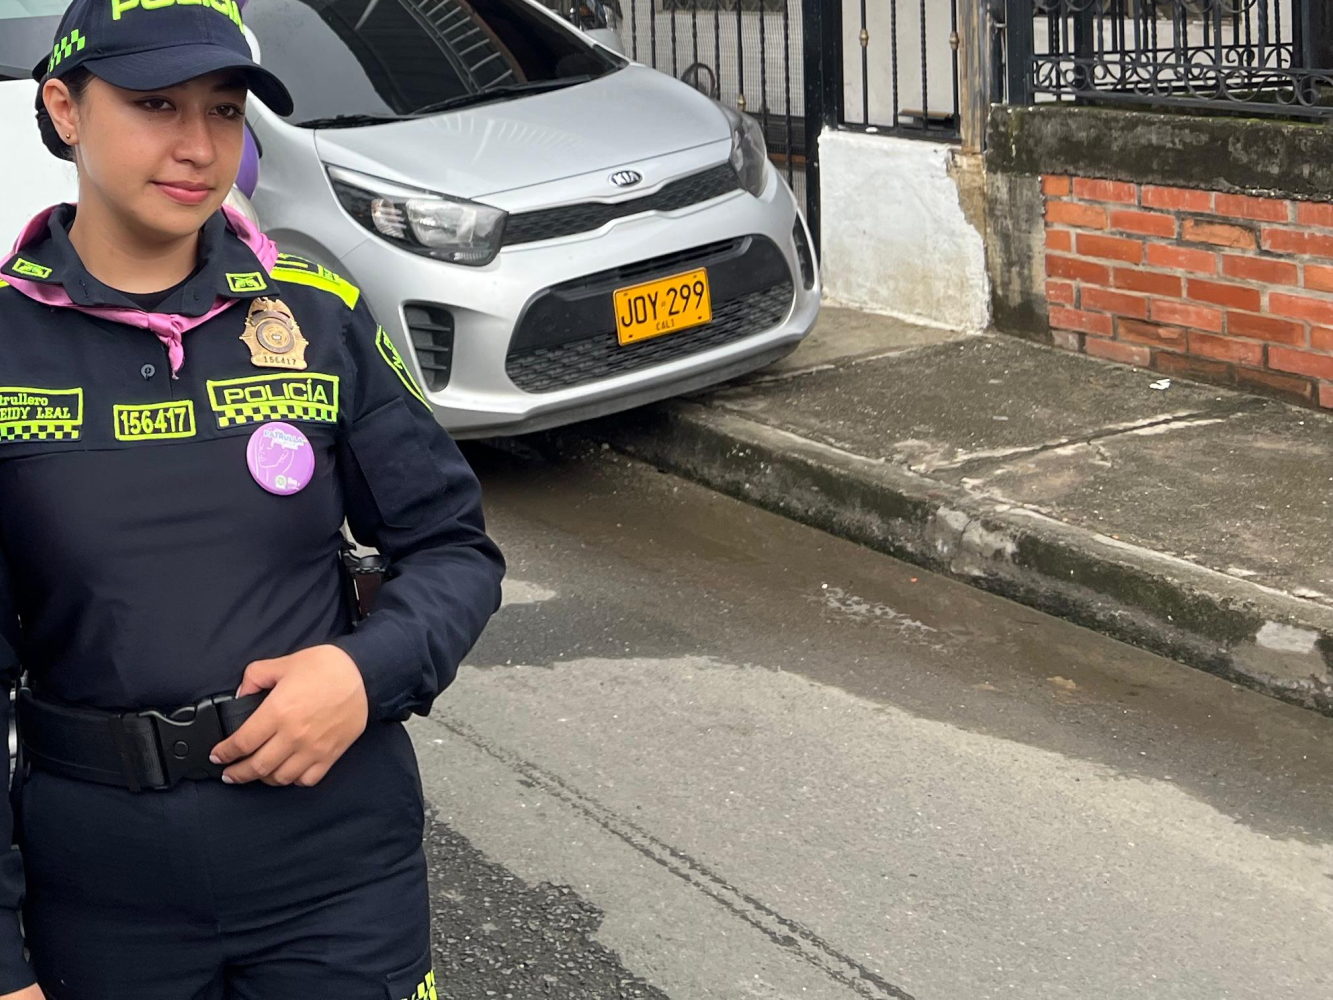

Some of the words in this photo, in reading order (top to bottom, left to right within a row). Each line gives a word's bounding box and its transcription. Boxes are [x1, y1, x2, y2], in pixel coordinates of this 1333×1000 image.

[611, 171, 642, 187] KIA
[666, 280, 705, 316] 299
[655, 320, 675, 331] CALI
[222, 378, 329, 405] POLICÍA
[35, 407, 71, 420] LEAL
[120, 407, 187, 436] 156417
